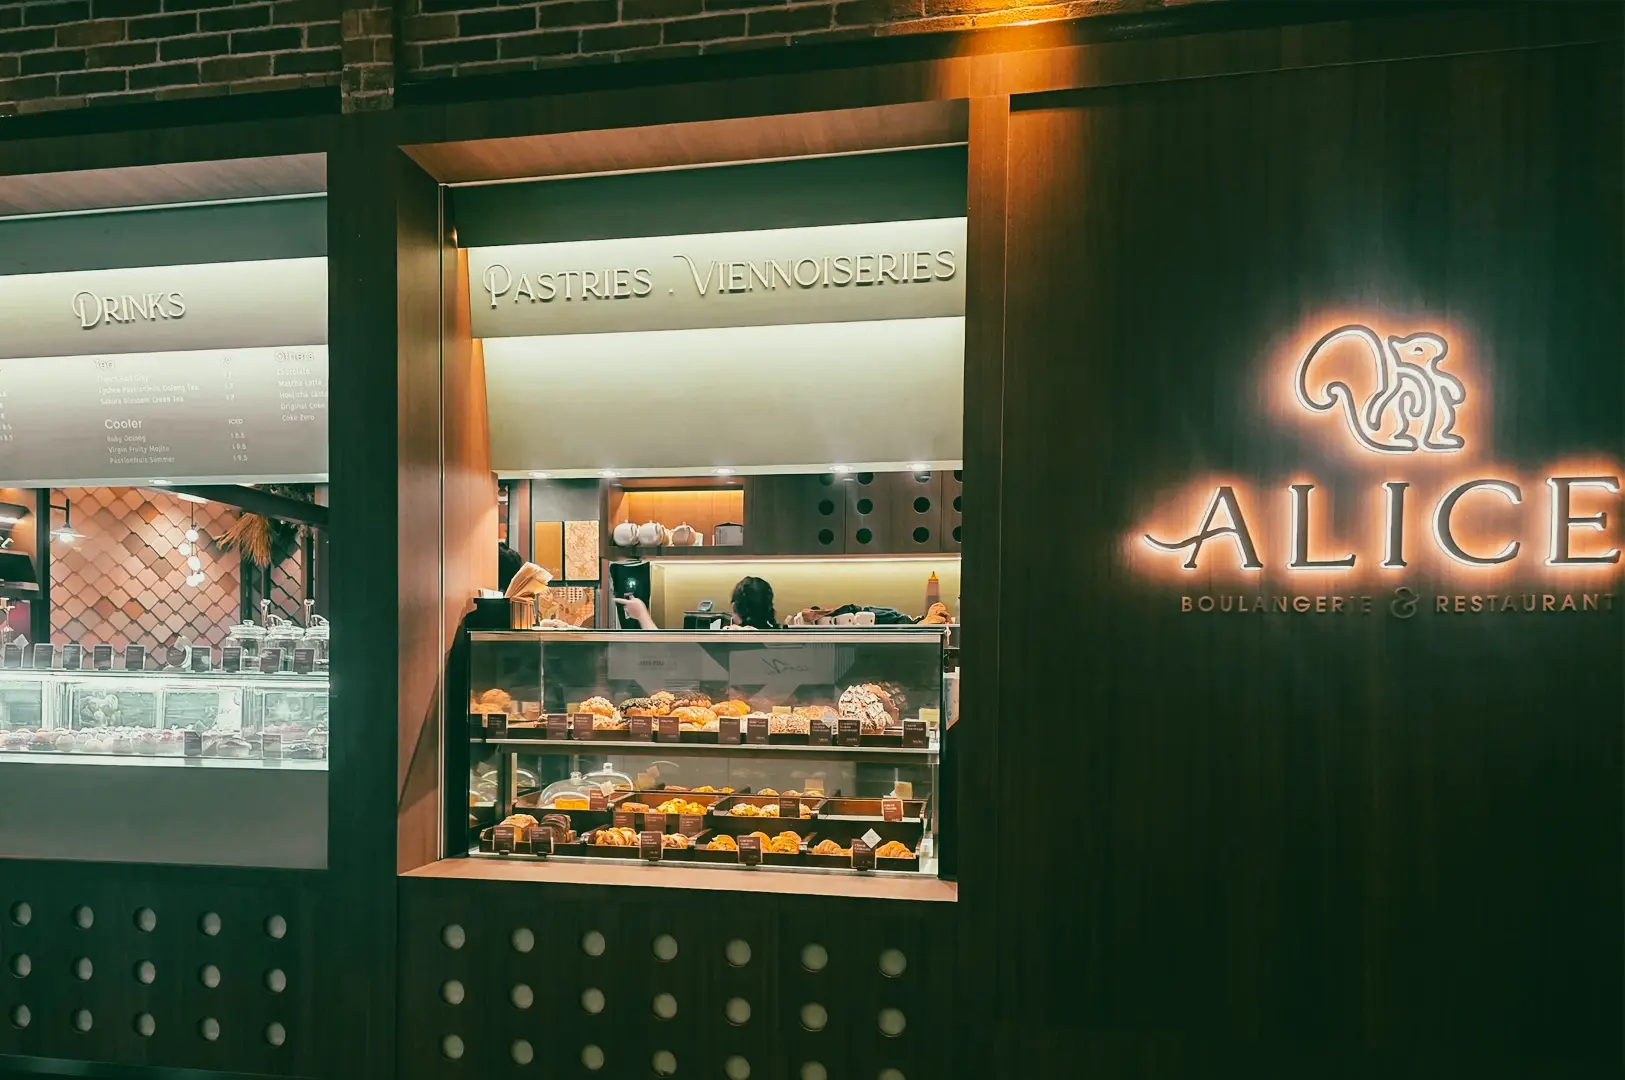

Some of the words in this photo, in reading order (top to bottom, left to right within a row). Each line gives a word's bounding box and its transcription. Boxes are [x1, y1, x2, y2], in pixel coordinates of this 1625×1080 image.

[482, 262, 653, 308] PASTRIES
[673, 248, 957, 296] VIENNOISERIES
[72, 291, 186, 330] DRINKS
[104, 418, 143, 430] Cooler
[1143, 475, 1622, 571] ALICE
[1181, 594, 1373, 614] BOULANGERIE
[1390, 586, 1419, 619] &
[1435, 592, 1616, 613] RESTAURANT
